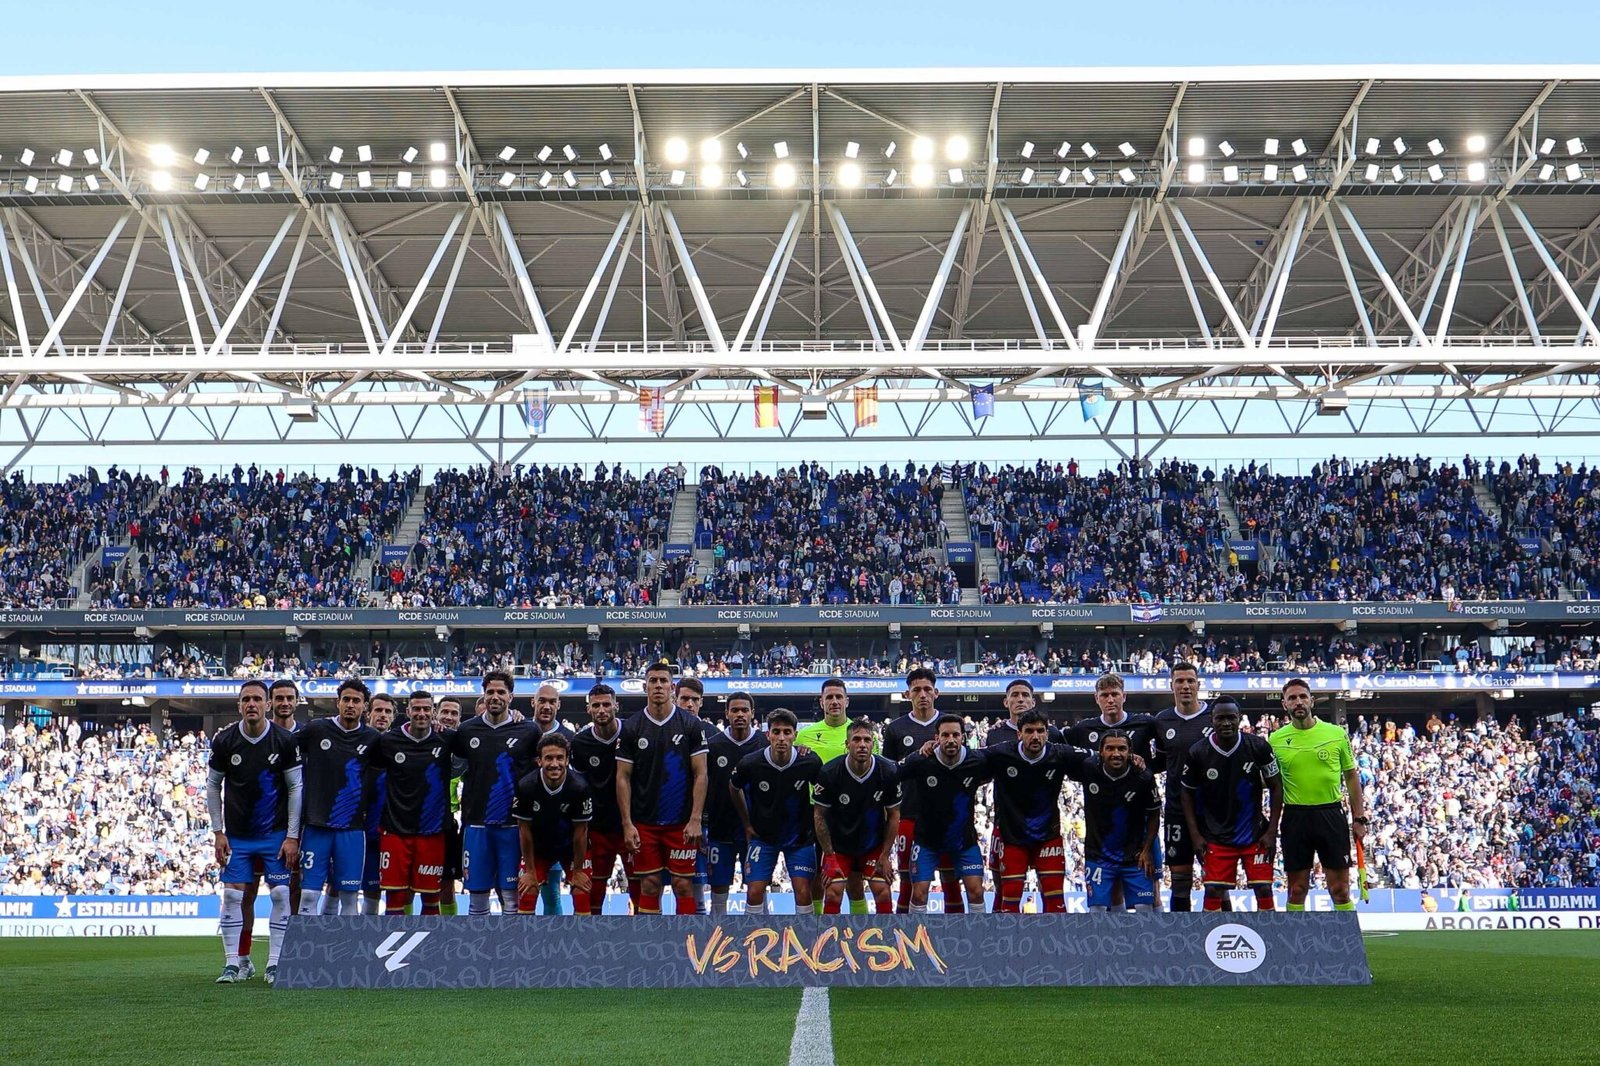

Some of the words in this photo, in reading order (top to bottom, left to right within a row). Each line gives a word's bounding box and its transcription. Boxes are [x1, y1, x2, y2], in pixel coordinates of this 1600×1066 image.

[819, 610, 843, 618] RCDE
[844, 610, 880, 618] STADIUM
[930, 609, 954, 618] RCDE
[956, 609, 992, 618] STADIUM
[1032, 609, 1056, 617] RCDE
[1058, 609, 1093, 617] STADIUM
[1170, 608, 1205, 616] STADIUM
[1246, 607, 1270, 615] RCDE
[1271, 607, 1307, 615] STADIUM
[1352, 607, 1376, 615] RCDE
[1378, 607, 1414, 615] STADIUM
[1465, 606, 1489, 615] RCDE
[1490, 606, 1526, 615] STADIUM
[1566, 606, 1590, 614] RCDE
[8, 614, 43, 622] STADIUM
[84, 614, 108, 622] RCDE
[109, 614, 144, 622] STADIUM
[185, 613, 209, 622] RCDE
[210, 613, 245, 622] STADIUM
[293, 613, 316, 621] RCDE
[318, 613, 353, 621] STADIUM
[399, 612, 423, 620] RCDE
[424, 612, 459, 620] STADIUM
[504, 612, 528, 620] RCDE
[530, 612, 566, 620] STADIUM
[606, 611, 629, 620] RCDE
[631, 611, 667, 620] STADIUM
[718, 611, 741, 619] RCDE
[743, 611, 778, 619] STADIUM
[727, 681, 749, 689] RCDE
[750, 681, 783, 689] STADIUM
[865, 681, 898, 689] STADIUM
[944, 681, 966, 689] RCDE
[966, 681, 1000, 689] STADIUM
[1372, 674, 1439, 687] CaixaBank
[1480, 674, 1546, 687] CaixaBank
[4, 684, 37, 693] STADIUM
[88, 685, 129, 695] ESTRELLA
[417, 680, 475, 693] CaixaBank
[1166, 824, 1182, 842] 13
[746, 845, 762, 863] 14
[1086, 866, 1103, 886] 24
[1549, 895, 1597, 909] DAMM
[77, 902, 149, 916] ESTRELLA
[150, 902, 199, 916] DAMM
[1425, 916, 1561, 929] ABOGADOS
[1217, 935, 1255, 950] EA
[1216, 950, 1258, 960] SPORTS
